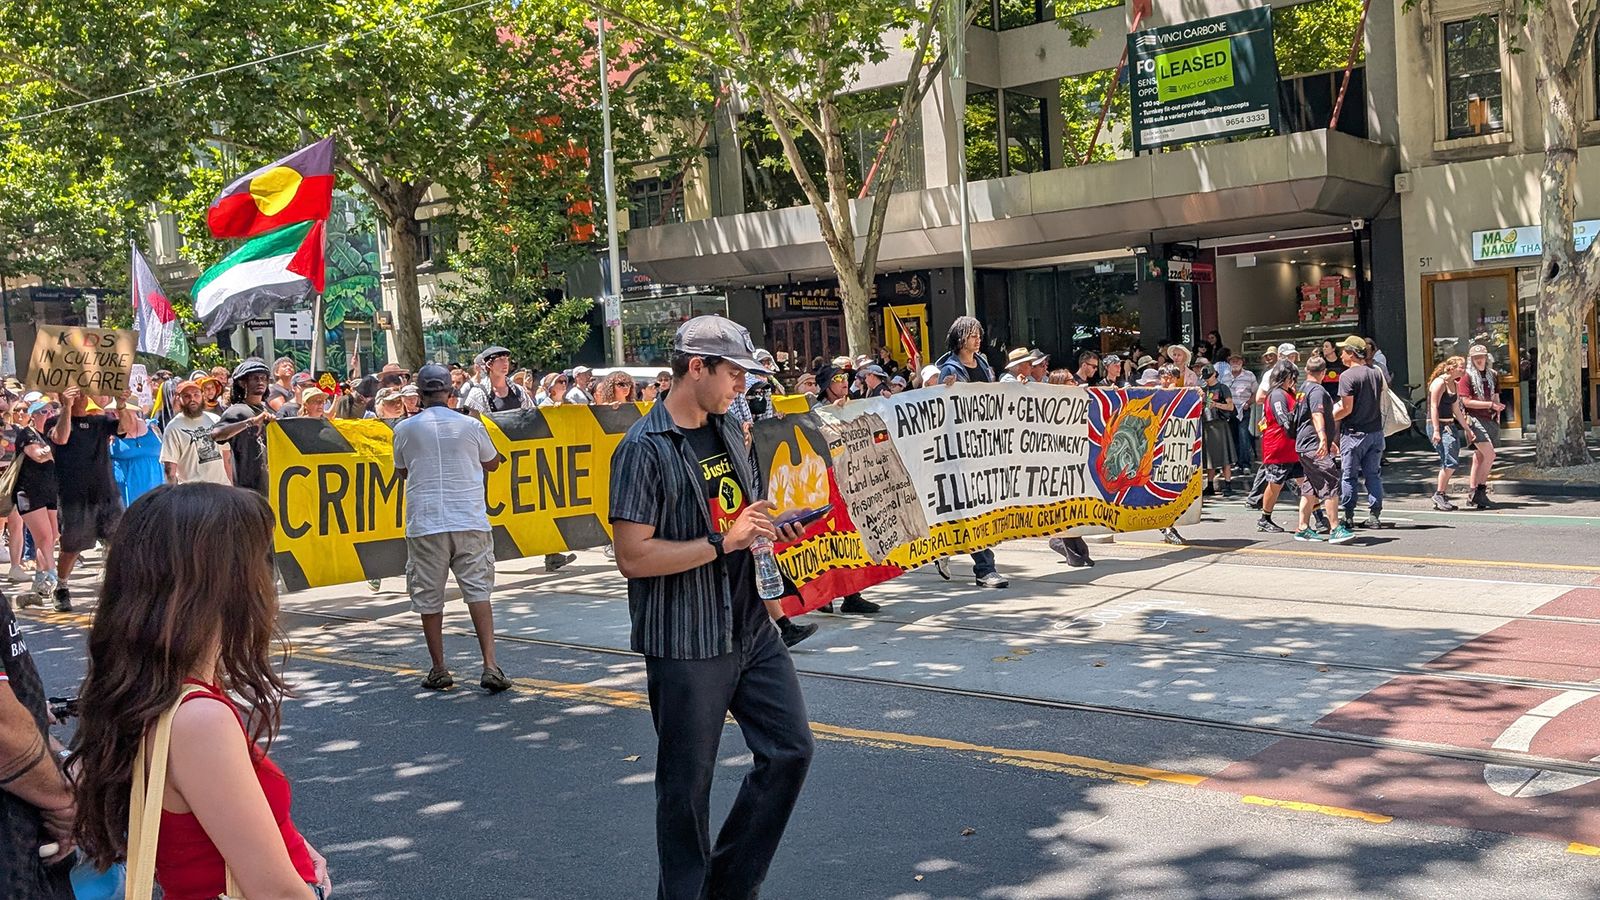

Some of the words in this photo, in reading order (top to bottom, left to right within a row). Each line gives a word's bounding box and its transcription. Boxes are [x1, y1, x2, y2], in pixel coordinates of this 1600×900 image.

[1157, 31, 1182, 44] VINCI
[1183, 21, 1227, 39] CARBONE
[1137, 58, 1155, 75] FO
[1160, 50, 1227, 80] LEASED
[1137, 78, 1157, 88] SENS
[1138, 87, 1158, 97] OPPO
[1178, 82, 1197, 92] VINCI
[1197, 74, 1229, 88] CARBONE
[1164, 104, 1181, 112] fit-out
[1181, 99, 1206, 110] provided
[1168, 112, 1187, 120] variety
[1194, 105, 1223, 116] hospitality
[1223, 101, 1250, 111] concepts
[1226, 117, 1245, 126] 9654
[1246, 113, 1266, 123] 3333
[1482, 231, 1503, 245] MA
[1481, 243, 1518, 258] NAAW
[1520, 242, 1541, 254] THA
[788, 297, 801, 305] The
[801, 297, 819, 305] Black
[819, 298, 838, 306] Prince
[57, 331, 116, 349] KDS
[39, 349, 54, 363] IN
[64, 351, 130, 367] CULTURE
[36, 368, 77, 387] NOT
[77, 370, 126, 391] CARE
[895, 397, 946, 438] ARMED
[950, 393, 1005, 424] INVASION
[1017, 396, 1091, 426] GENOCIDE
[841, 427, 872, 444] SOVEREIGN
[1163, 418, 1198, 440] DOWN
[848, 439, 870, 454] TREATY
[1020, 429, 1088, 457] GOVERNMENT
[1161, 442, 1194, 462] WITH
[847, 460, 860, 476] End
[863, 454, 875, 469] the
[876, 454, 890, 466] war
[1151, 464, 1169, 482] THE
[871, 466, 890, 485] back
[883, 475, 911, 494] released
[1025, 463, 1087, 498] TREATY
[278, 462, 404, 539] CRIM
[484, 444, 593, 517] CENE
[904, 490, 917, 505] law
[909, 528, 972, 560] AUSTRALIA
[1037, 501, 1090, 527] CRIMINAL
[1092, 503, 1121, 527] COURT
[880, 530, 899, 556] Peace
[779, 545, 819, 581] AUTION
[818, 536, 863, 564] GENOCIDE
